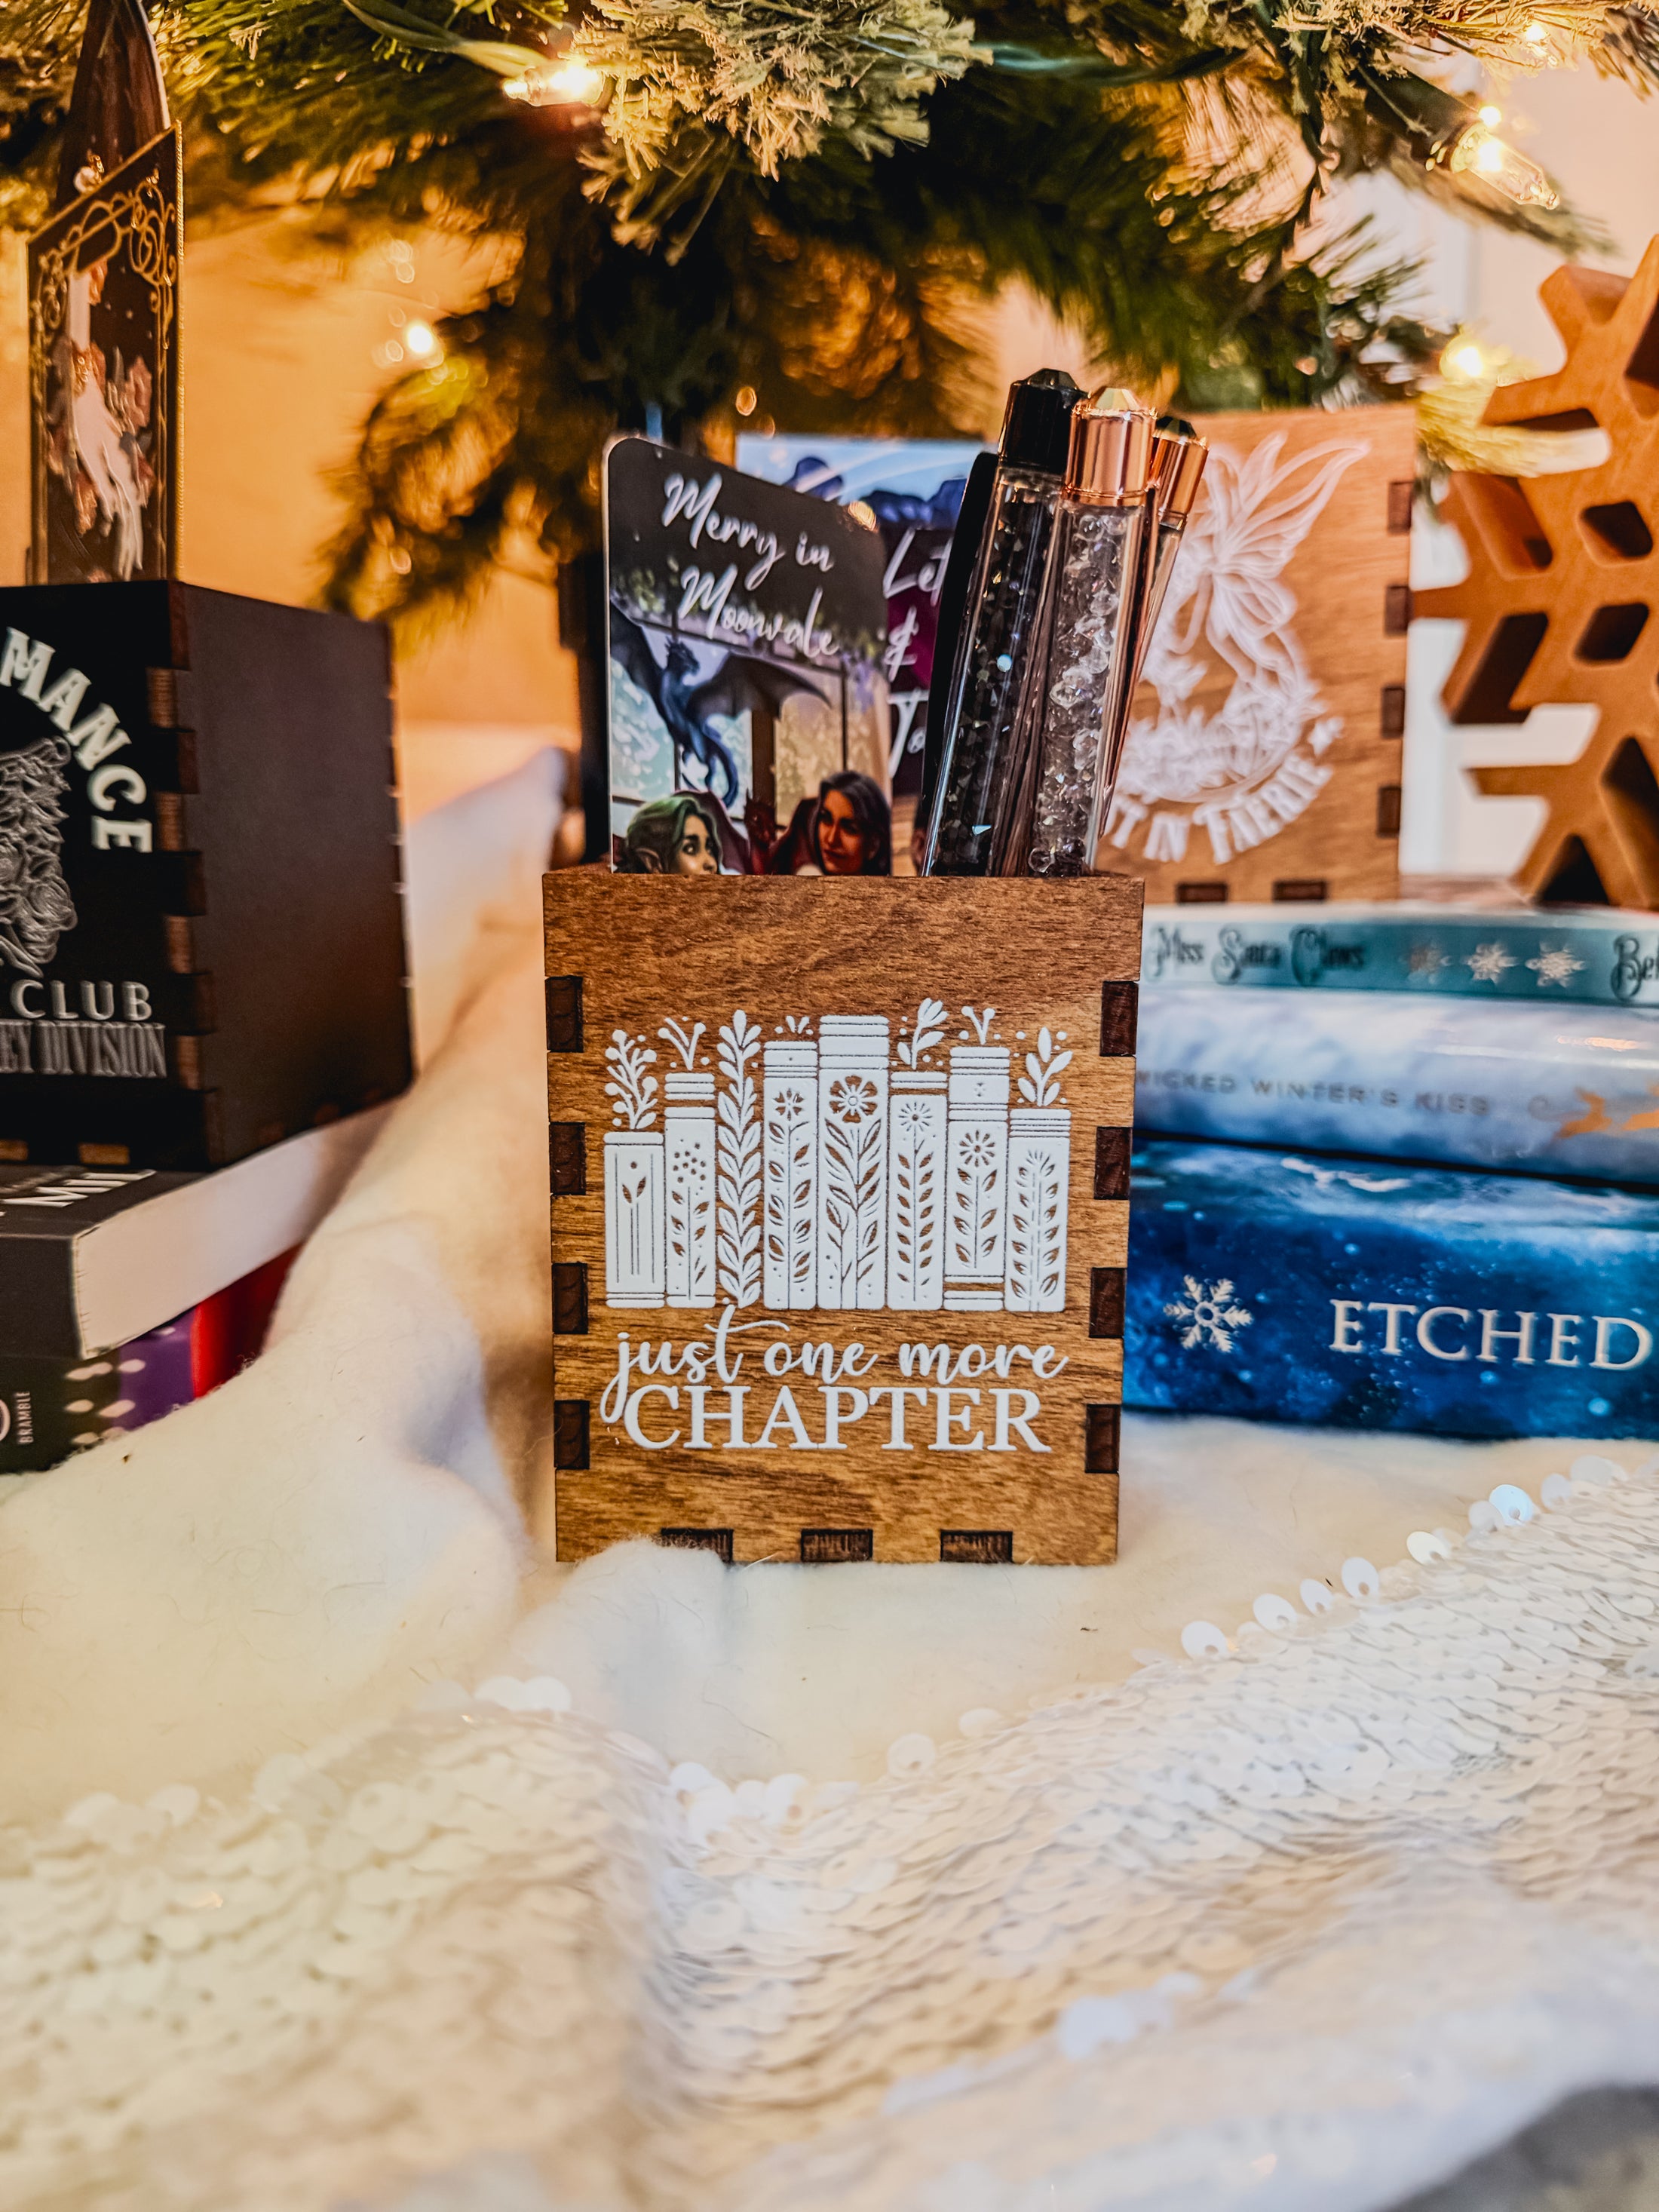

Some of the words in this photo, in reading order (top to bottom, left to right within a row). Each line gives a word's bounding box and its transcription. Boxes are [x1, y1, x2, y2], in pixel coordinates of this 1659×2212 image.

[662, 472, 786, 591] Merry
[796, 531, 834, 572] in
[679, 563, 839, 658] Moonvale
[0, 627, 152, 853] MANCE
[10, 979, 152, 1021] CLUB
[1414, 1088, 1491, 1118] KISS
[600, 1304, 790, 1424] just
[764, 1341, 879, 1385] one
[898, 1342, 1069, 1385] more
[1329, 1298, 1654, 1371] ETCHED
[15, 1390, 34, 1443] BRAMBLE
[623, 1384, 1053, 1453] CHAPTER
